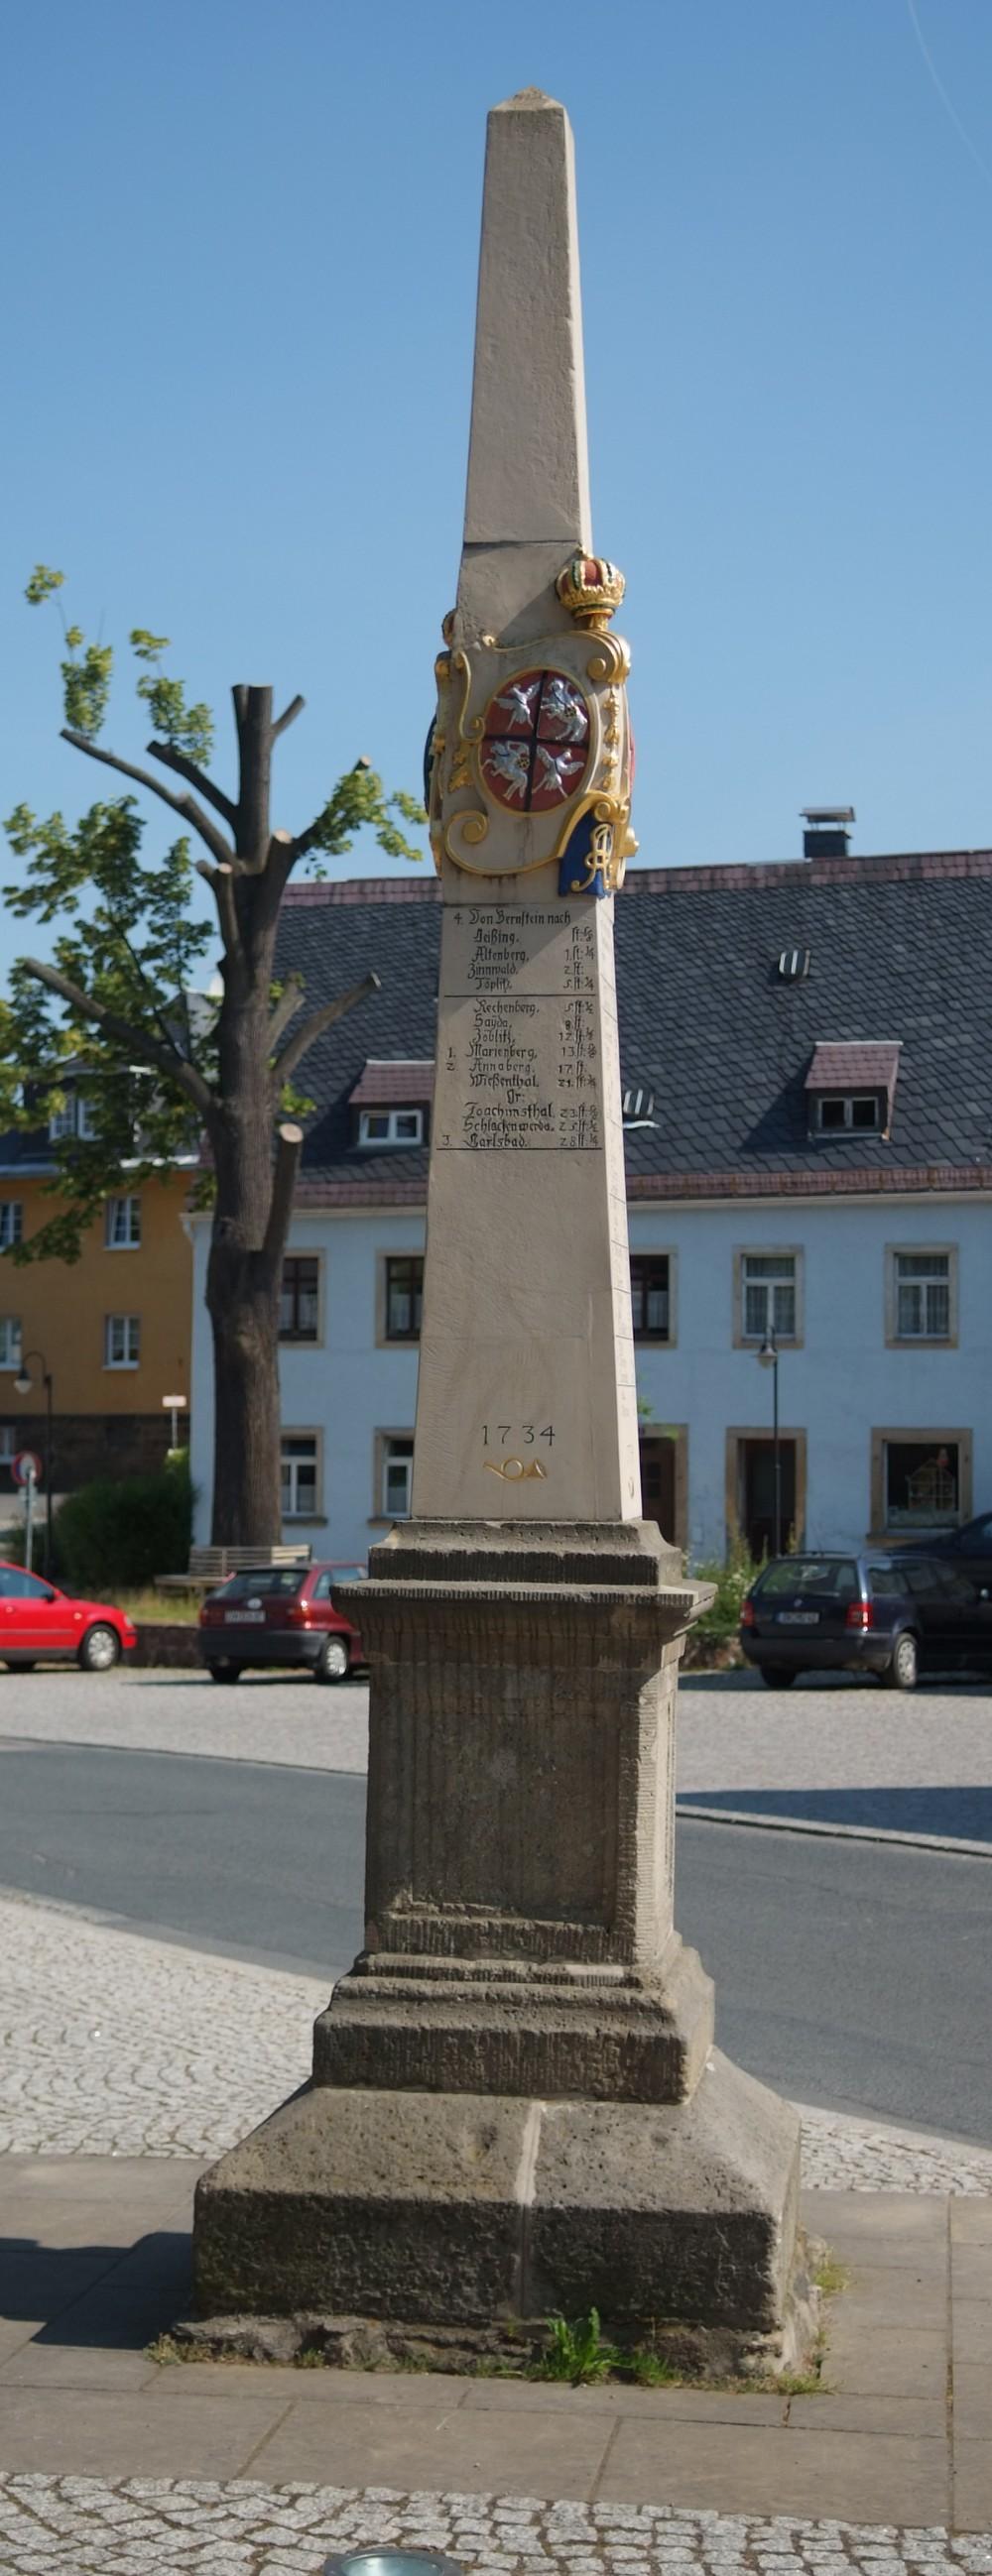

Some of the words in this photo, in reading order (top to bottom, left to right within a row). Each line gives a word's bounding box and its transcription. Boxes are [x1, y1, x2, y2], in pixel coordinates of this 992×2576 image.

[469, 907, 493, 925] Von
[548, 910, 571, 926] nach
[482, 1425, 556, 1447] 1734
